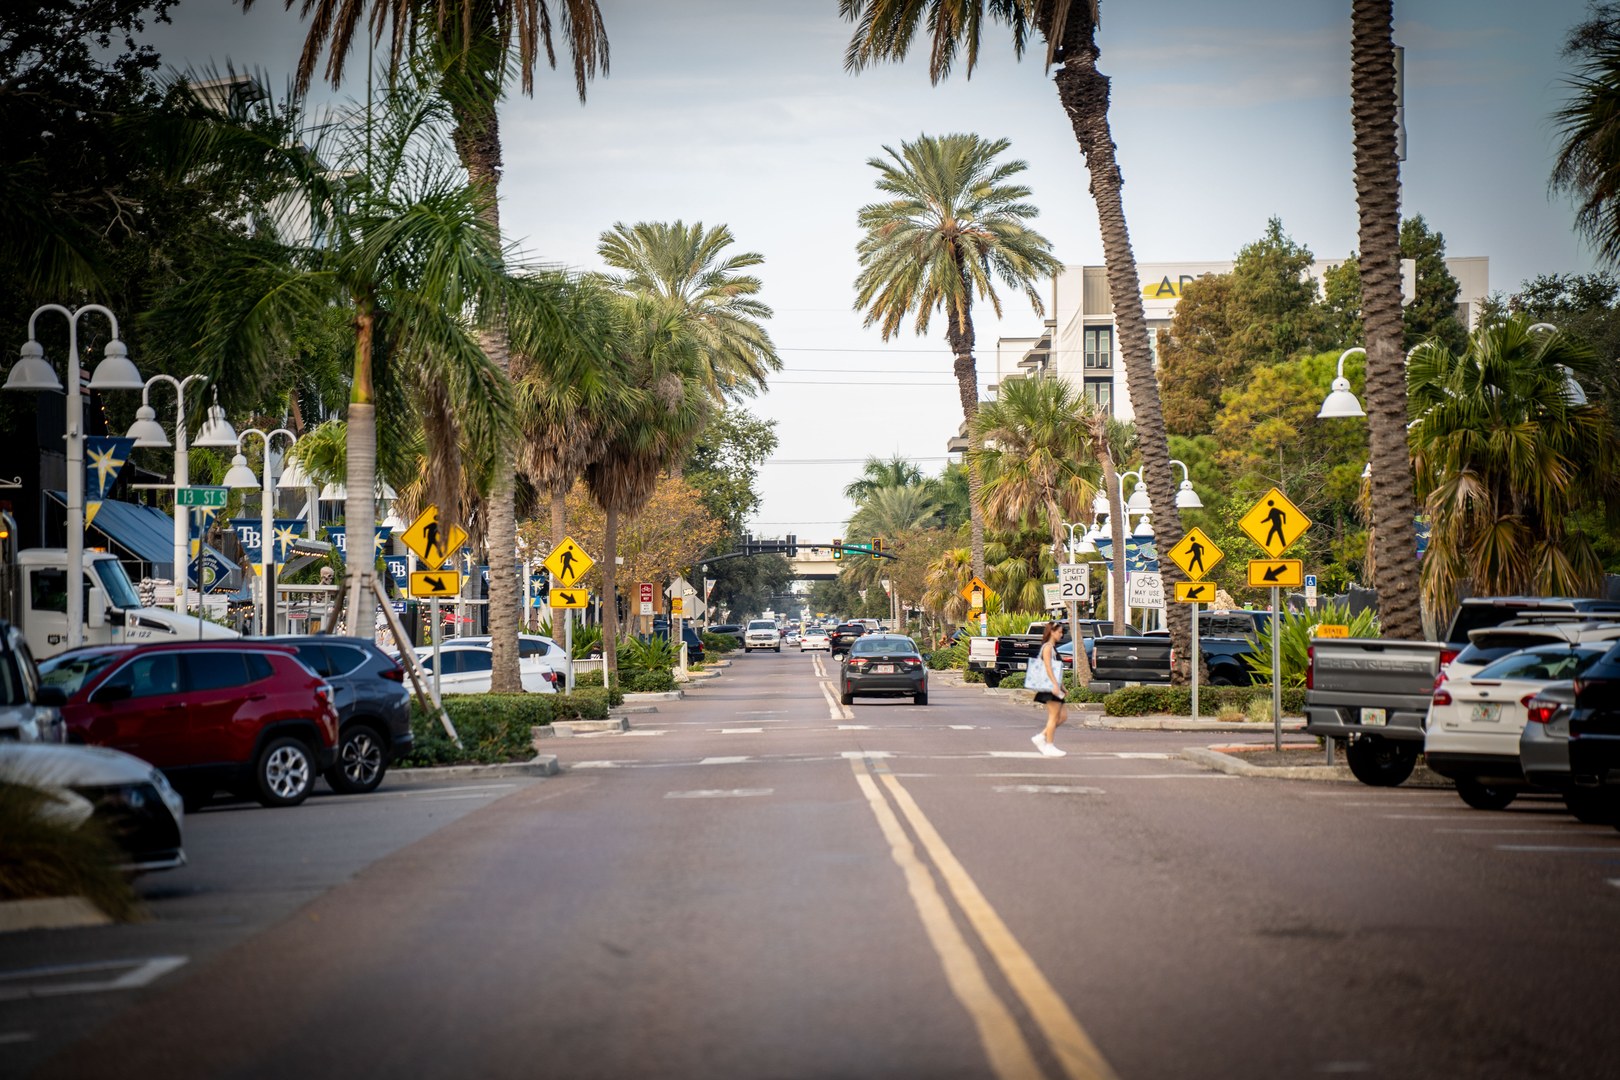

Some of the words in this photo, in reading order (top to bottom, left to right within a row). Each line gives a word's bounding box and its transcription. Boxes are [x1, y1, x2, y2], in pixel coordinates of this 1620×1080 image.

[183, 490, 194, 504] 13
[203, 491, 215, 504] ST
[219, 491, 225, 505] S
[237, 526, 261, 548] TB
[332, 533, 347, 552] T
[388, 561, 406, 577] TB
[1062, 583, 1085, 596] 20
[1318, 657, 1429, 671] CHEVROLET
